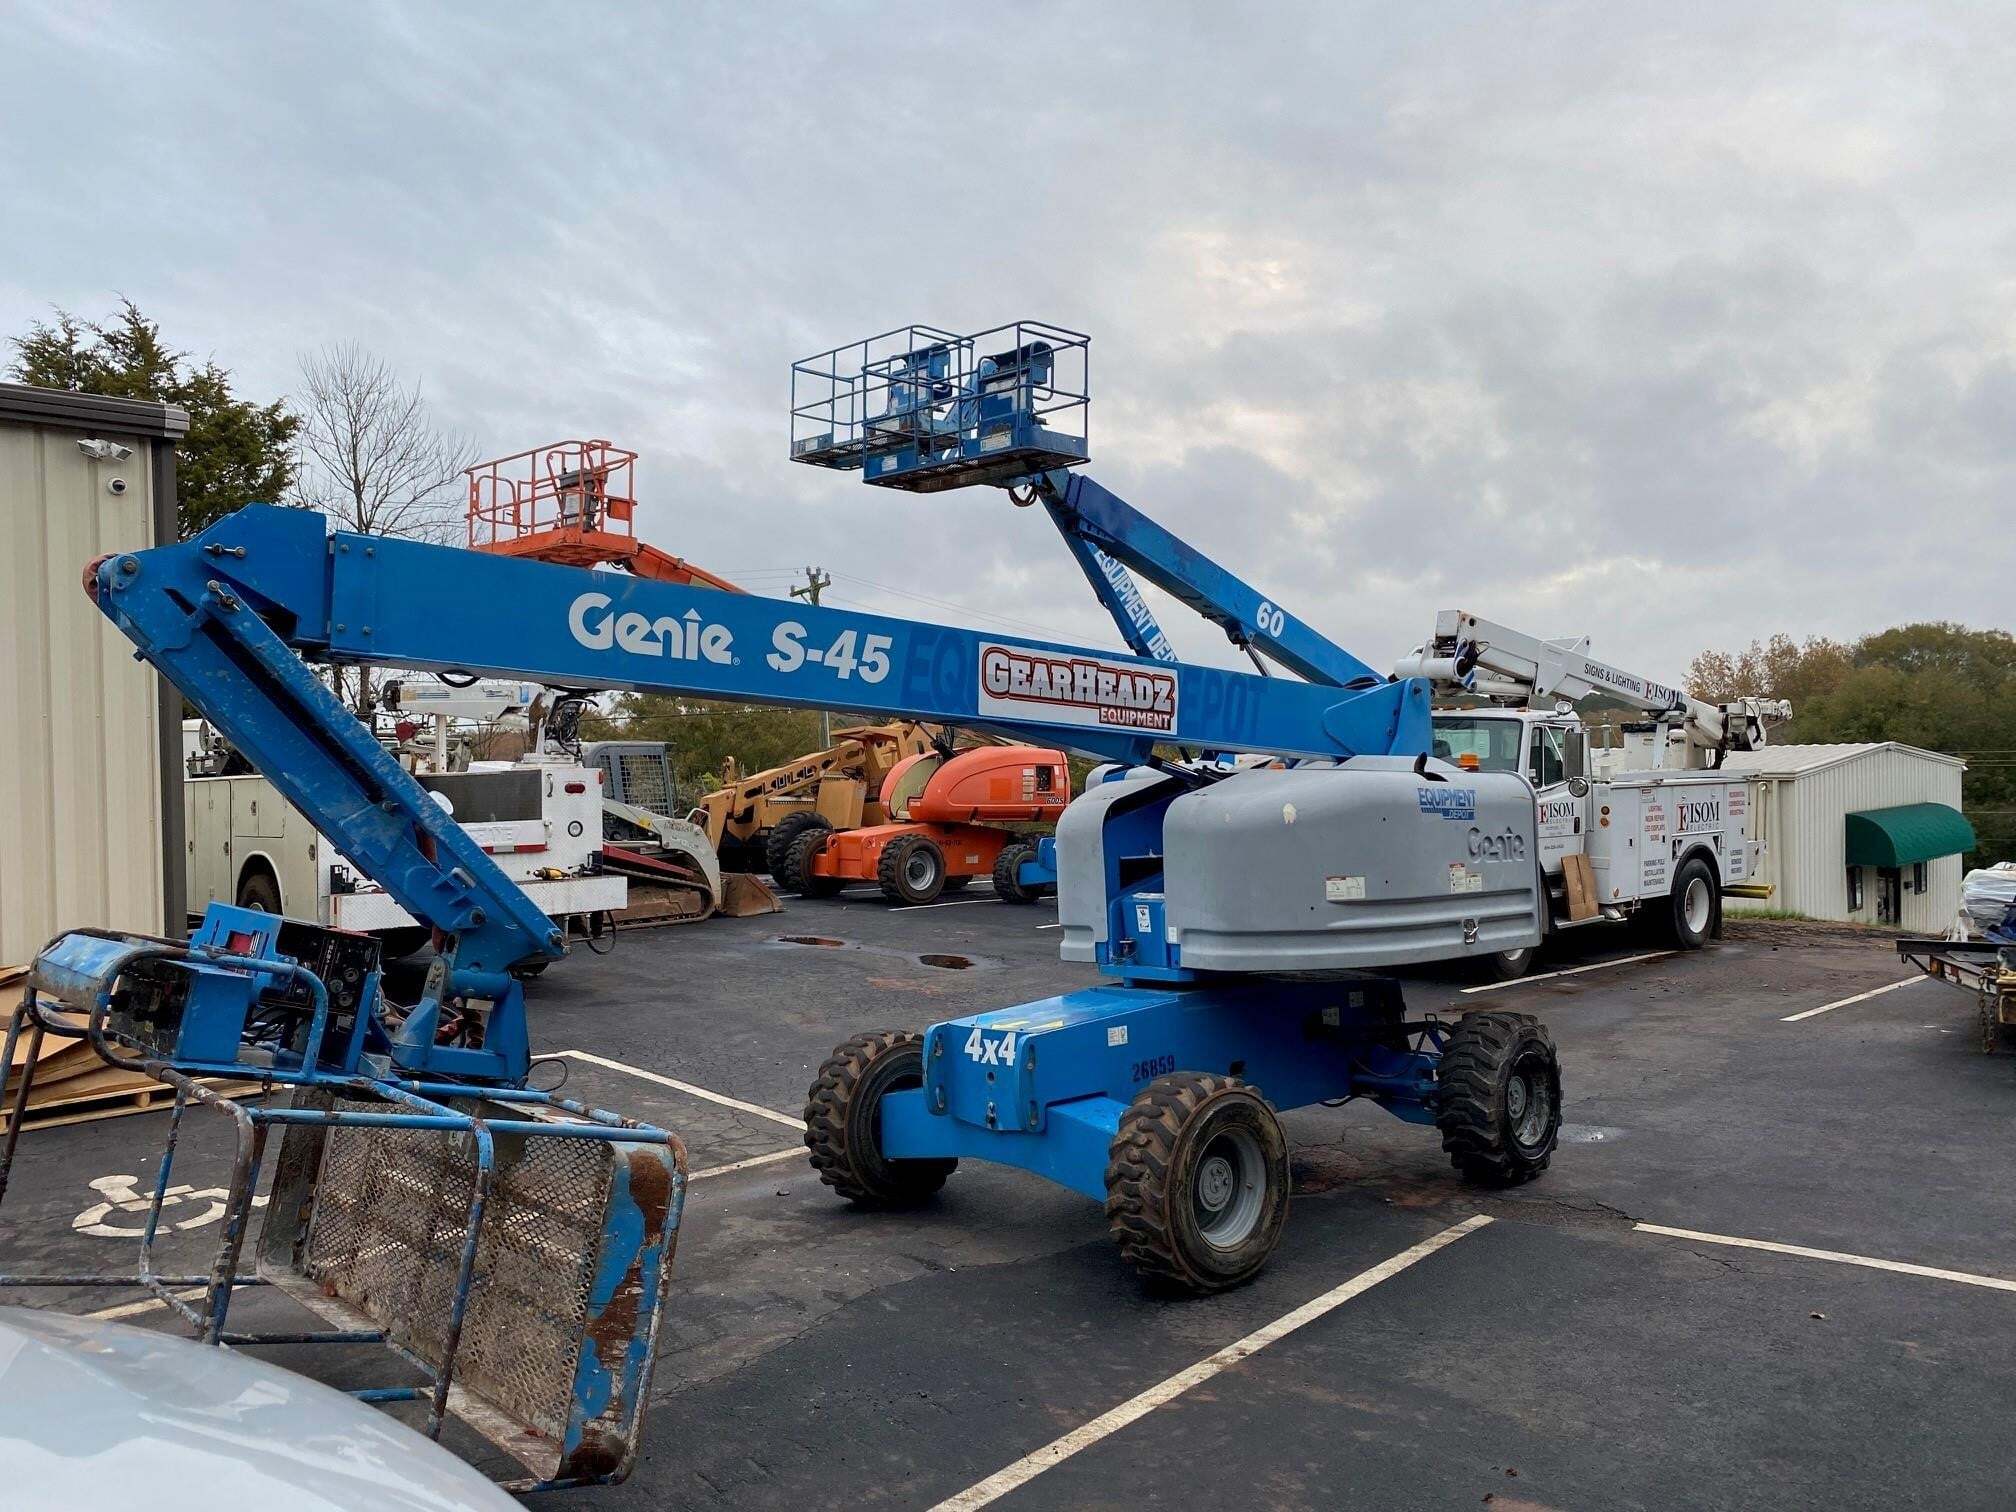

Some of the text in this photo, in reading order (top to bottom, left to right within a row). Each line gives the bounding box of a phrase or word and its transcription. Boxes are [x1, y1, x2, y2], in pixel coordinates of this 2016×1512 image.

[568, 592, 734, 665] Genie
[1256, 601, 1285, 638] 60
[766, 621, 893, 684] S-45
[982, 647, 1176, 714] GEARHEADZ
[1584, 663, 1604, 680] SIGNS
[1605, 671, 1611, 682] &
[1612, 673, 1640, 693] LIGHTING
[1100, 706, 1173, 730] EQUIPMENT
[1417, 787, 1477, 809] EQUIPMENT
[1467, 826, 1526, 863] Genie
[963, 1028, 1017, 1067] 4x4
[1132, 1055, 1175, 1082] 26859
